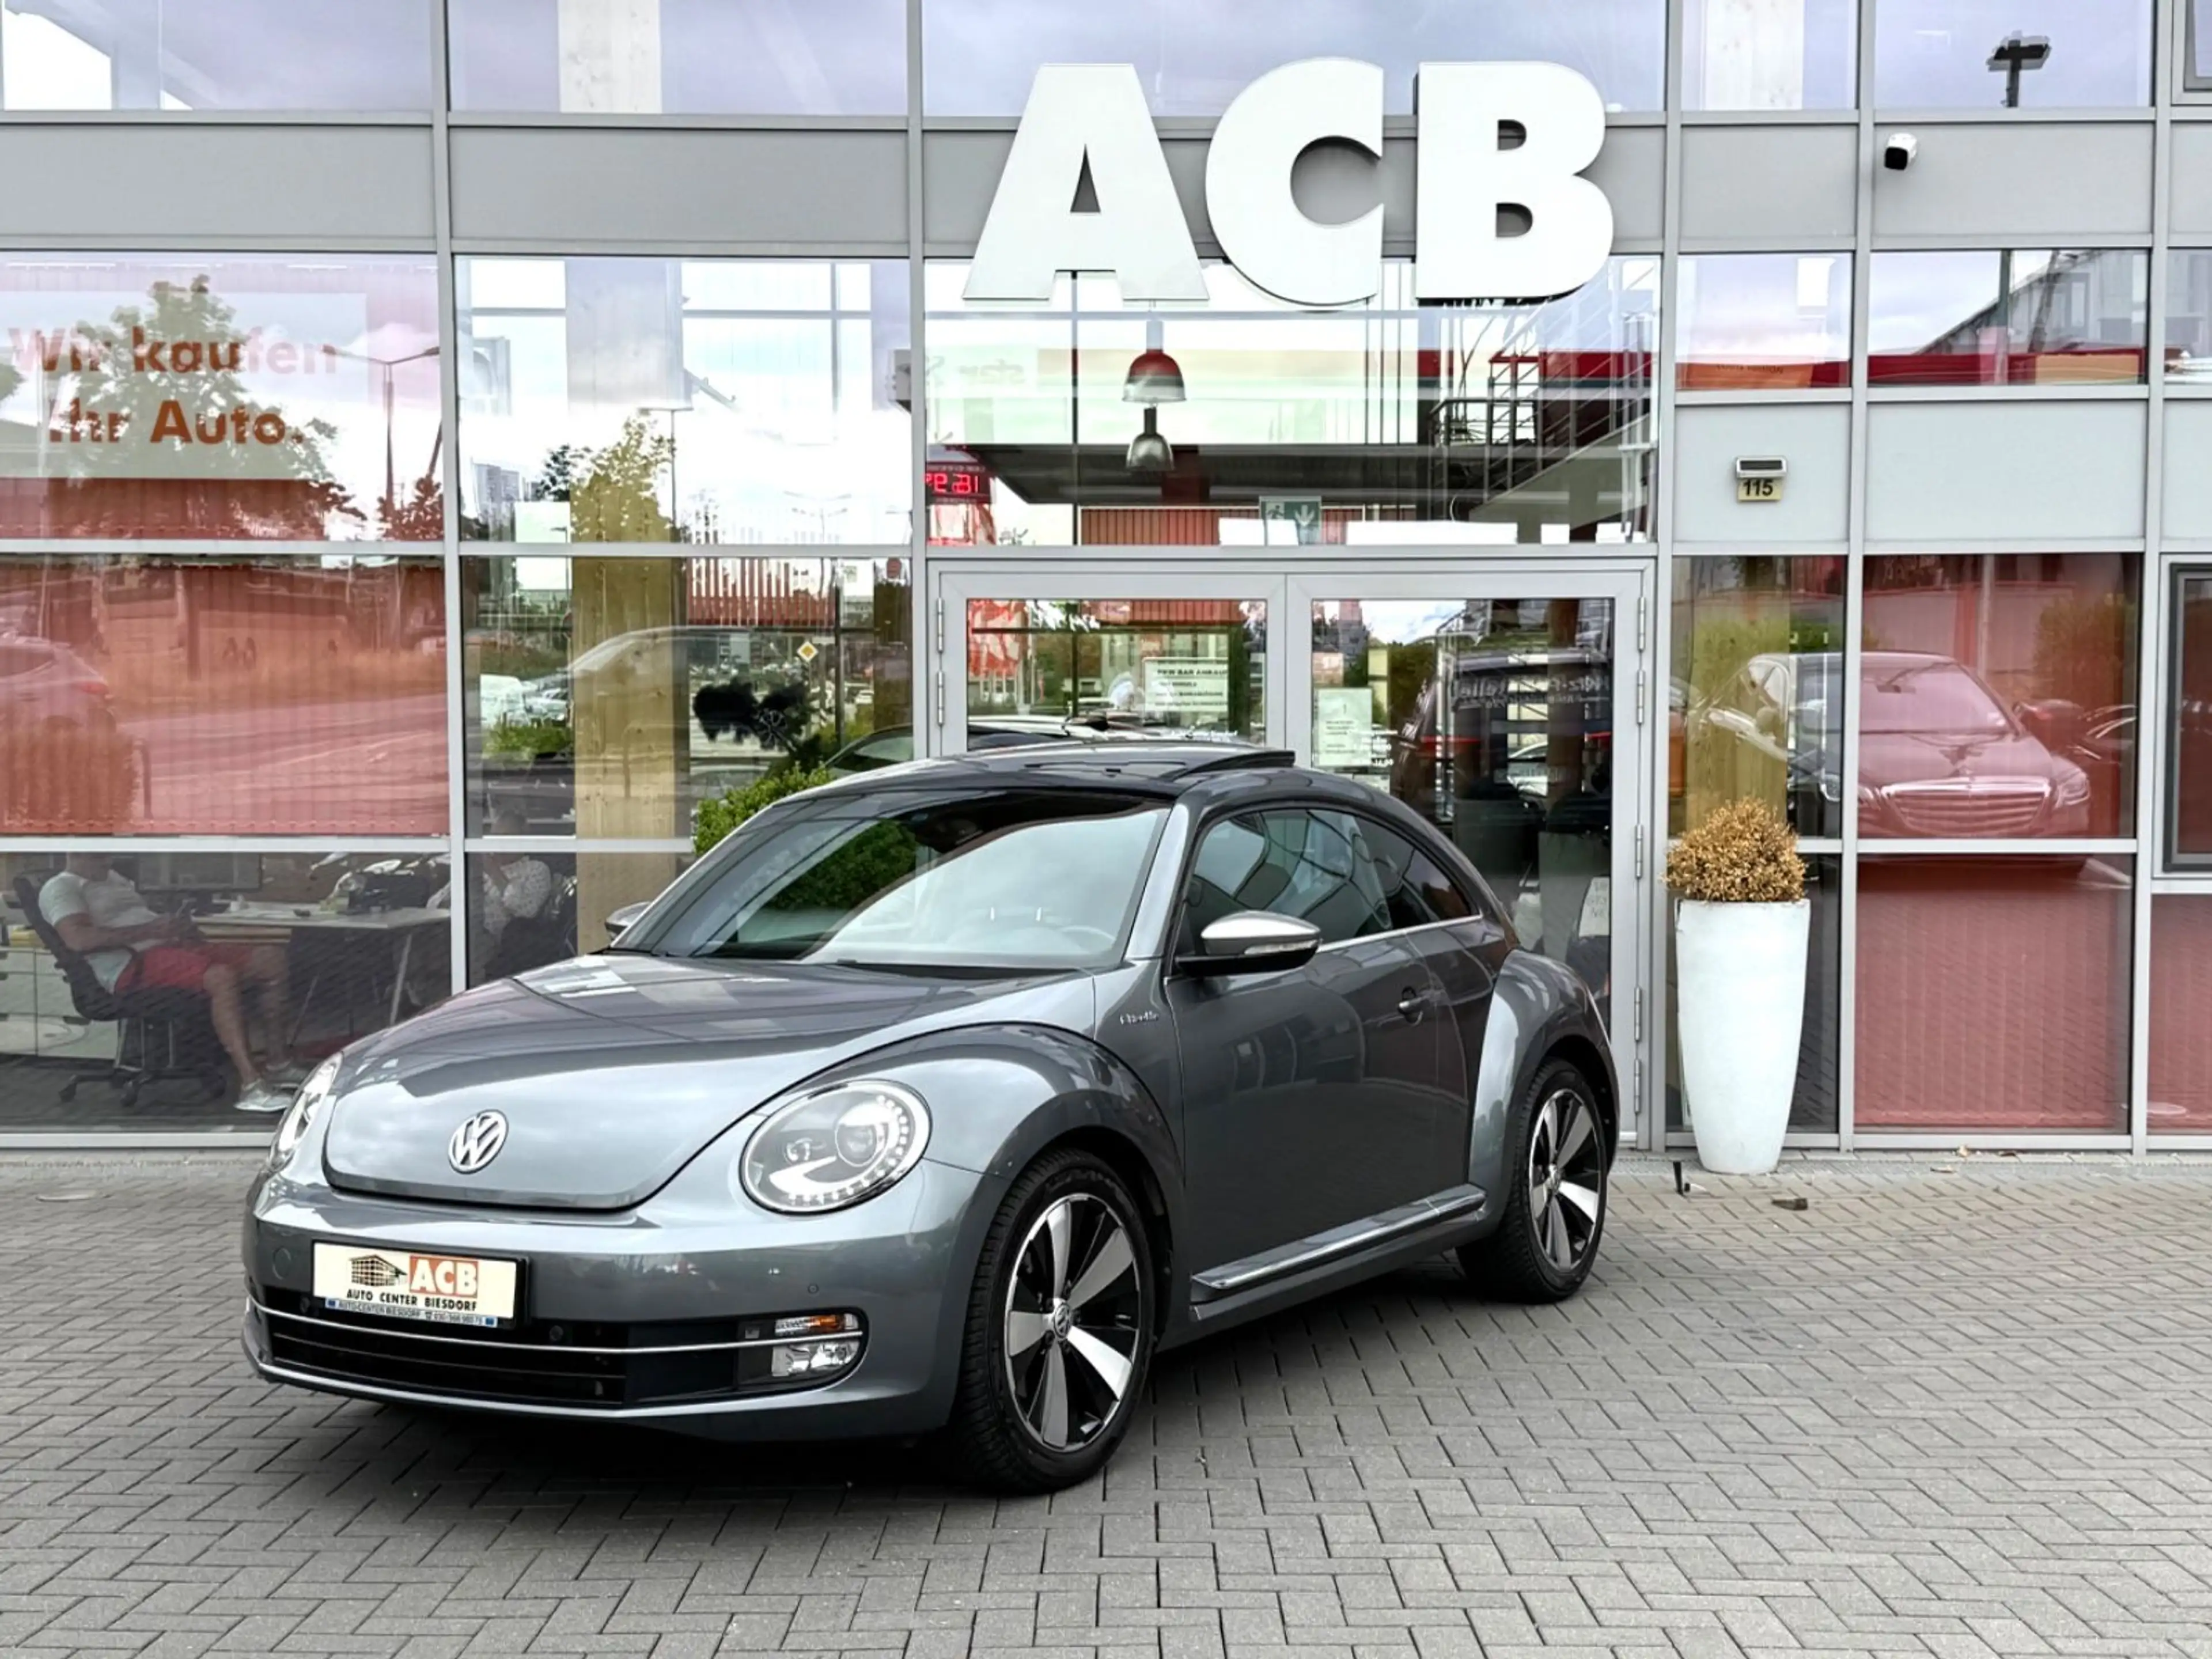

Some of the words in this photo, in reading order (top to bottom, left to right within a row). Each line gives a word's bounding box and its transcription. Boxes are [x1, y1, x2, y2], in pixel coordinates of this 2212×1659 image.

[961, 56, 1614, 306] ACB
[132, 325, 337, 375] kaufen
[48, 398, 130, 444] Ihr
[149, 399, 304, 445] Auto.
[1743, 479, 1774, 497] 115
[448, 1111, 507, 1173] VW
[347, 1289, 373, 1301] AUTO
[379, 1291, 418, 1306] CENTER
[425, 1297, 477, 1311] BIESDORF
[410, 1259, 477, 1296] ACB
